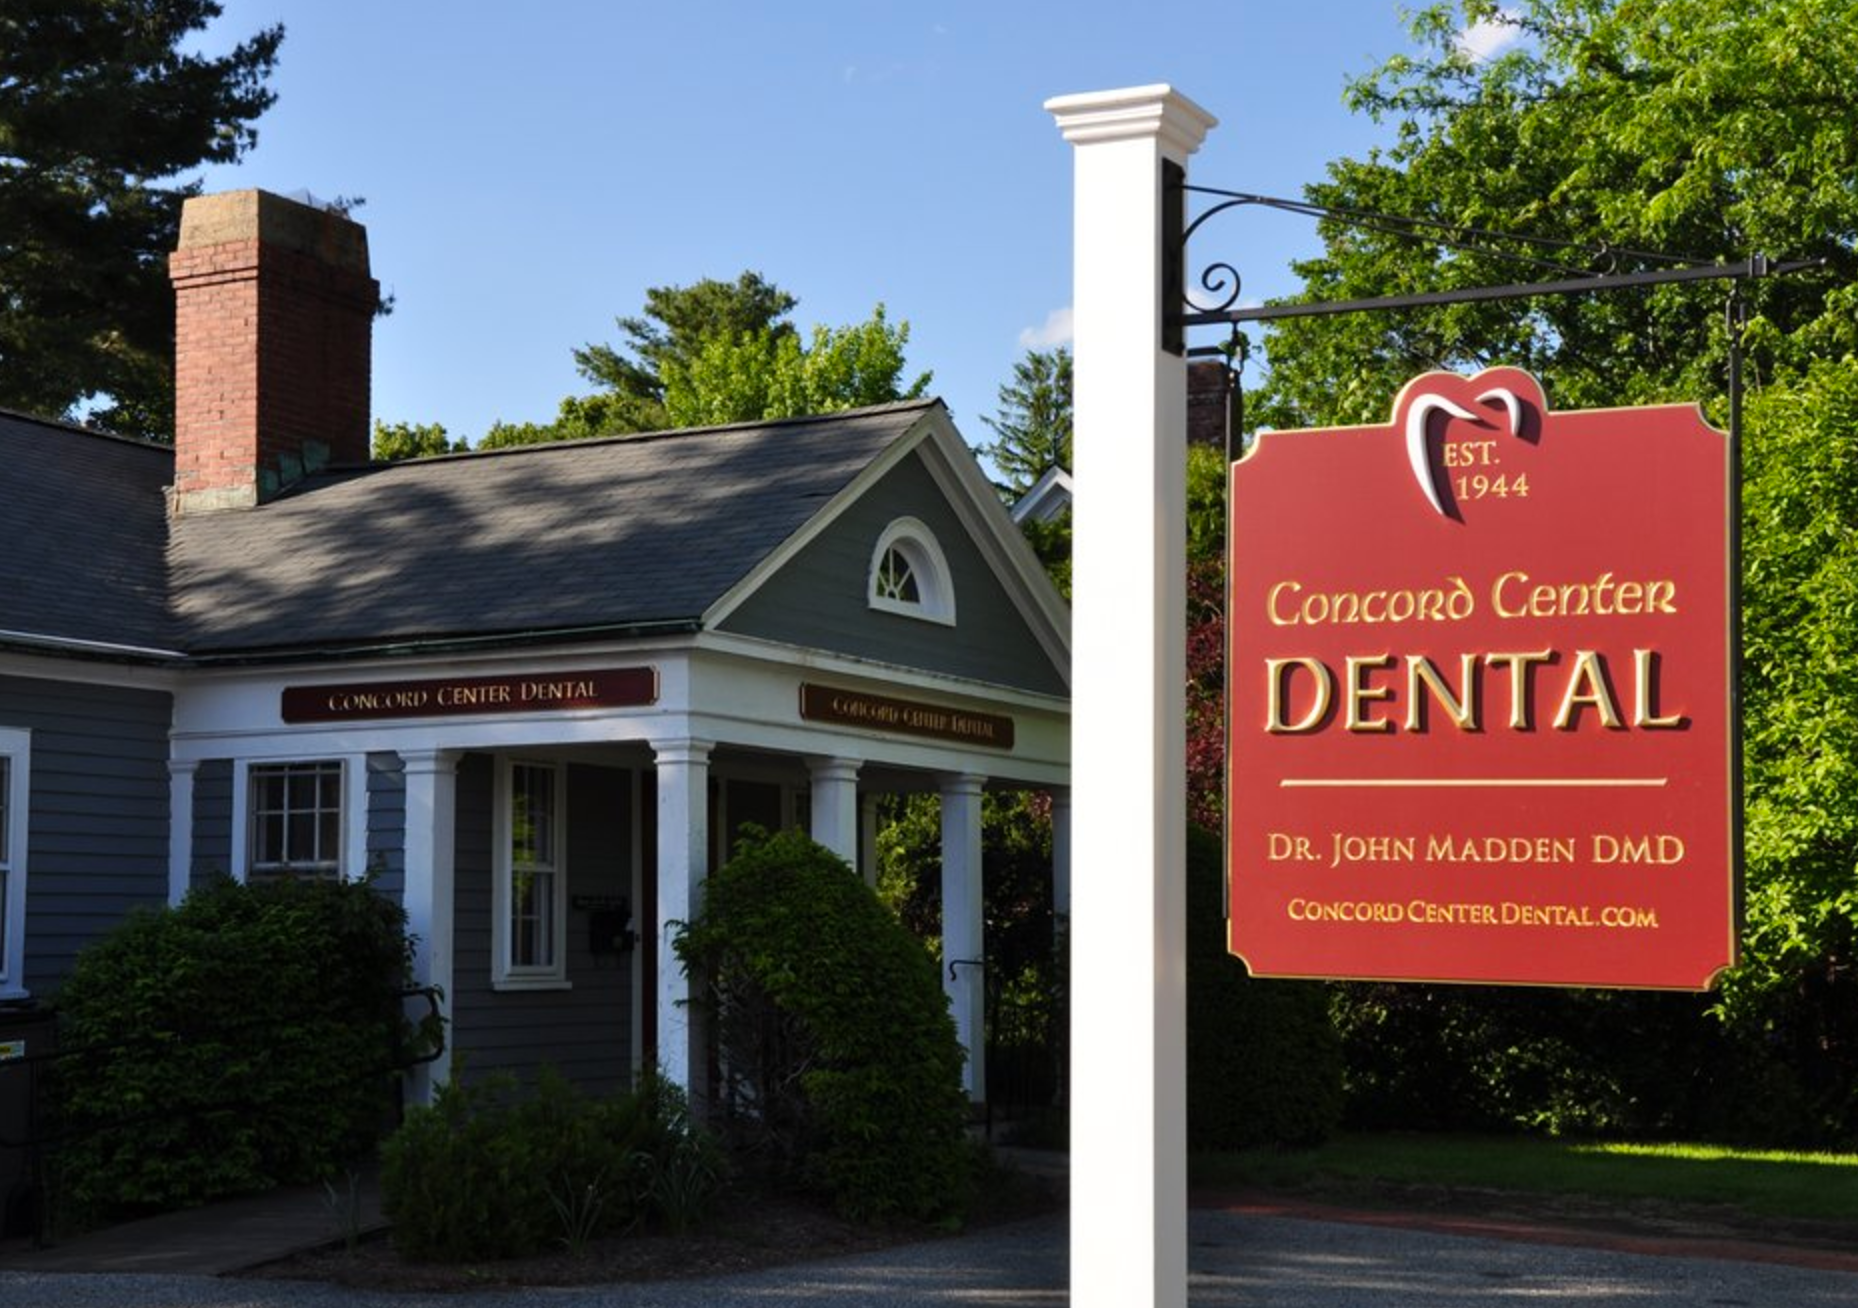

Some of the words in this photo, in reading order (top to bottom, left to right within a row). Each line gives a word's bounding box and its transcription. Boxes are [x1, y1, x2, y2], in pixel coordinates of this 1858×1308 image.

[1442, 441, 1500, 467] EST.
[1456, 473, 1530, 500] 1944
[328, 691, 427, 712] CONCORD
[437, 685, 511, 707] CENTER
[521, 680, 598, 700] DENTAL
[1264, 648, 1685, 733] DENTAL
[1330, 833, 1415, 868] JOHN
[1425, 834, 1575, 863] MADDEN
[1591, 835, 1685, 865] DMD
